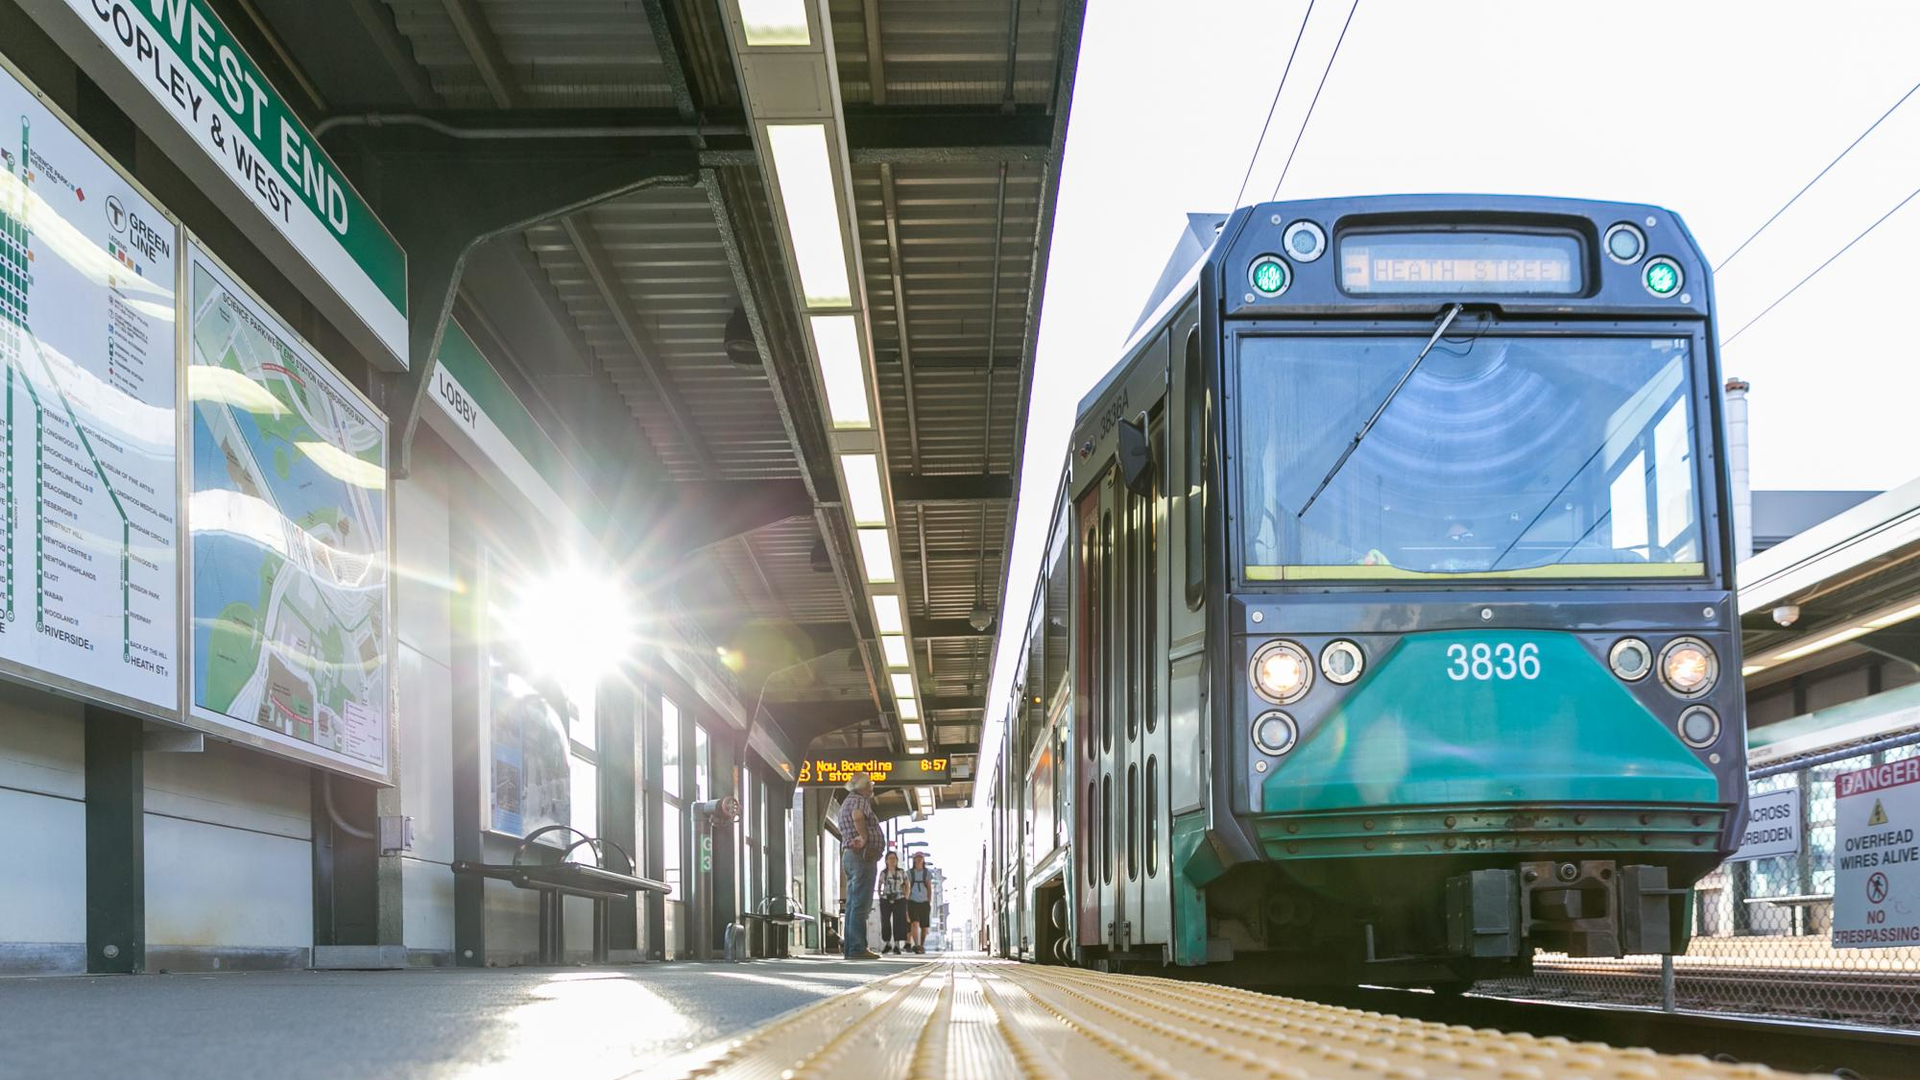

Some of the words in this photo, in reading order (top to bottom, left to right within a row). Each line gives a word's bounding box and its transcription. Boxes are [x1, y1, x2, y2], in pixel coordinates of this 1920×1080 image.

[148, 0, 269, 141] WEST
[280, 115, 349, 236] END
[29, 148, 54, 174] SCIENCE
[30, 157, 45, 174] WEST
[45, 169, 58, 184] END
[210, 113, 227, 156] &
[232, 134, 292, 223] WEST
[129, 212, 170, 258] GREEN
[130, 228, 156, 264] LINE
[1375, 261, 1456, 281] HEATH
[222, 292, 249, 324] SCIENCE
[283, 347, 296, 364] END
[295, 358, 318, 385] STATION
[439, 372, 477, 430] LOBBY
[43, 408, 65, 424] FENWAY
[43, 427, 75, 448] LONGWOOD
[43, 444, 74, 466] BROOKLINE
[73, 460, 94, 477] VILLAGE
[43, 462, 74, 484] BROOKLINE
[43, 499, 73, 517] RESERVOIR
[43, 516, 72, 534] CHESTNUT
[43, 535, 67, 550] NEWTON
[67, 545, 88, 560] CENTRE
[43, 553, 67, 568] NEWTON
[67, 561, 97, 581] HIGHLANDS
[43, 570, 59, 583] ELIOT
[43, 589, 64, 602] WABAN
[43, 608, 75, 625] WOODLAND
[44, 624, 90, 650] RIVERSIDE
[130, 655, 155, 673] HEATH
[155, 664, 165, 676] ST
[1446, 642, 1541, 681] 3836
[816, 760, 837, 771] Now
[841, 760, 892, 771] Boarding
[920, 759, 948, 771] 6:57
[817, 771, 823, 782] 1
[1841, 759, 1920, 796] DANGER
[1749, 803, 1791, 822] CROSS
[1740, 826, 1793, 846] RBIDDEN
[1845, 828, 1914, 852] OVERHEAD
[1840, 852, 1879, 870] WIRES
[1882, 846, 1919, 865] ALIVE
[1867, 909, 1886, 924] NO
[1834, 926, 1920, 944] TRESPASSING
